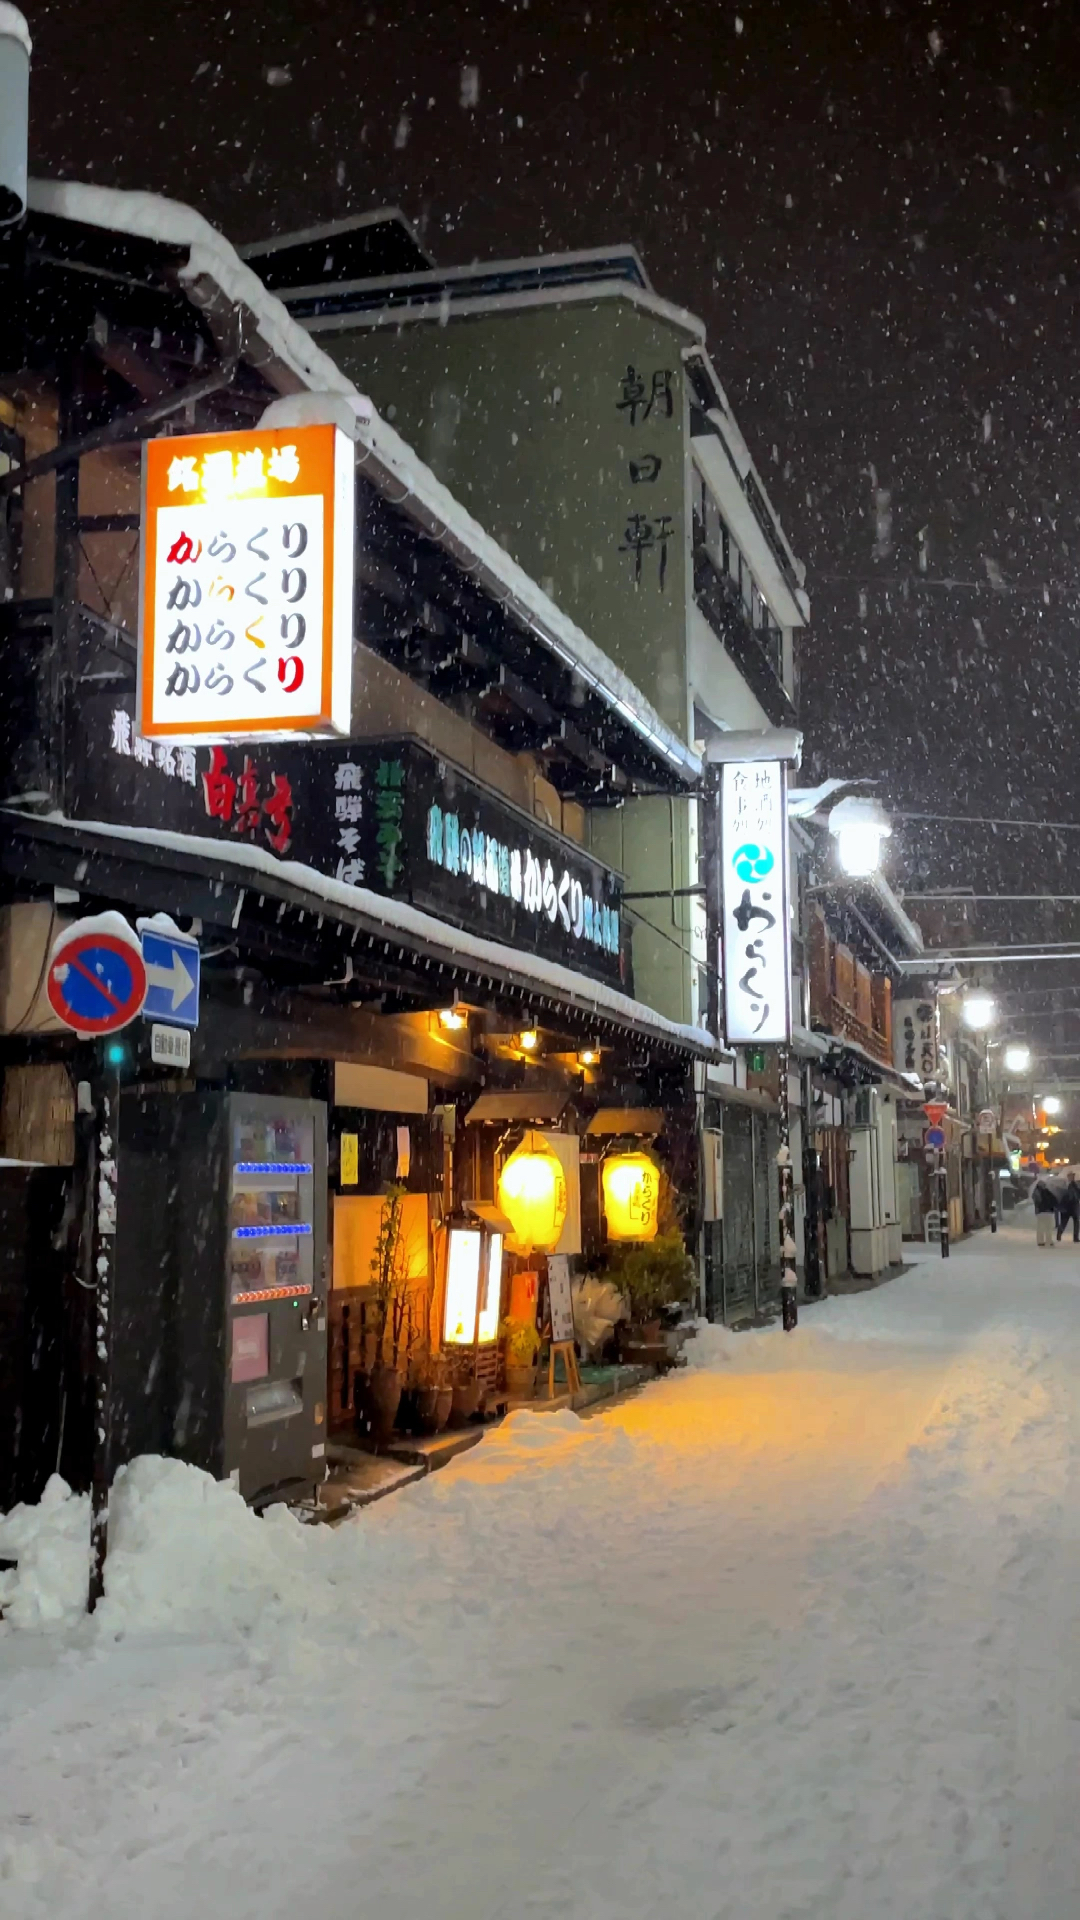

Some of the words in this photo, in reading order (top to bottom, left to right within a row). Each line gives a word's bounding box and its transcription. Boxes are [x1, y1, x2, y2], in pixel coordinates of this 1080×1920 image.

[616, 364, 675, 594] 朝日軒
[167, 522, 308, 564] からくり
[166, 567, 308, 610] からくり
[165, 612, 307, 654] からくり
[165, 655, 304, 696] からくり
[334, 762, 366, 885] 飛騨そば
[732, 888, 776, 1034] からくり
